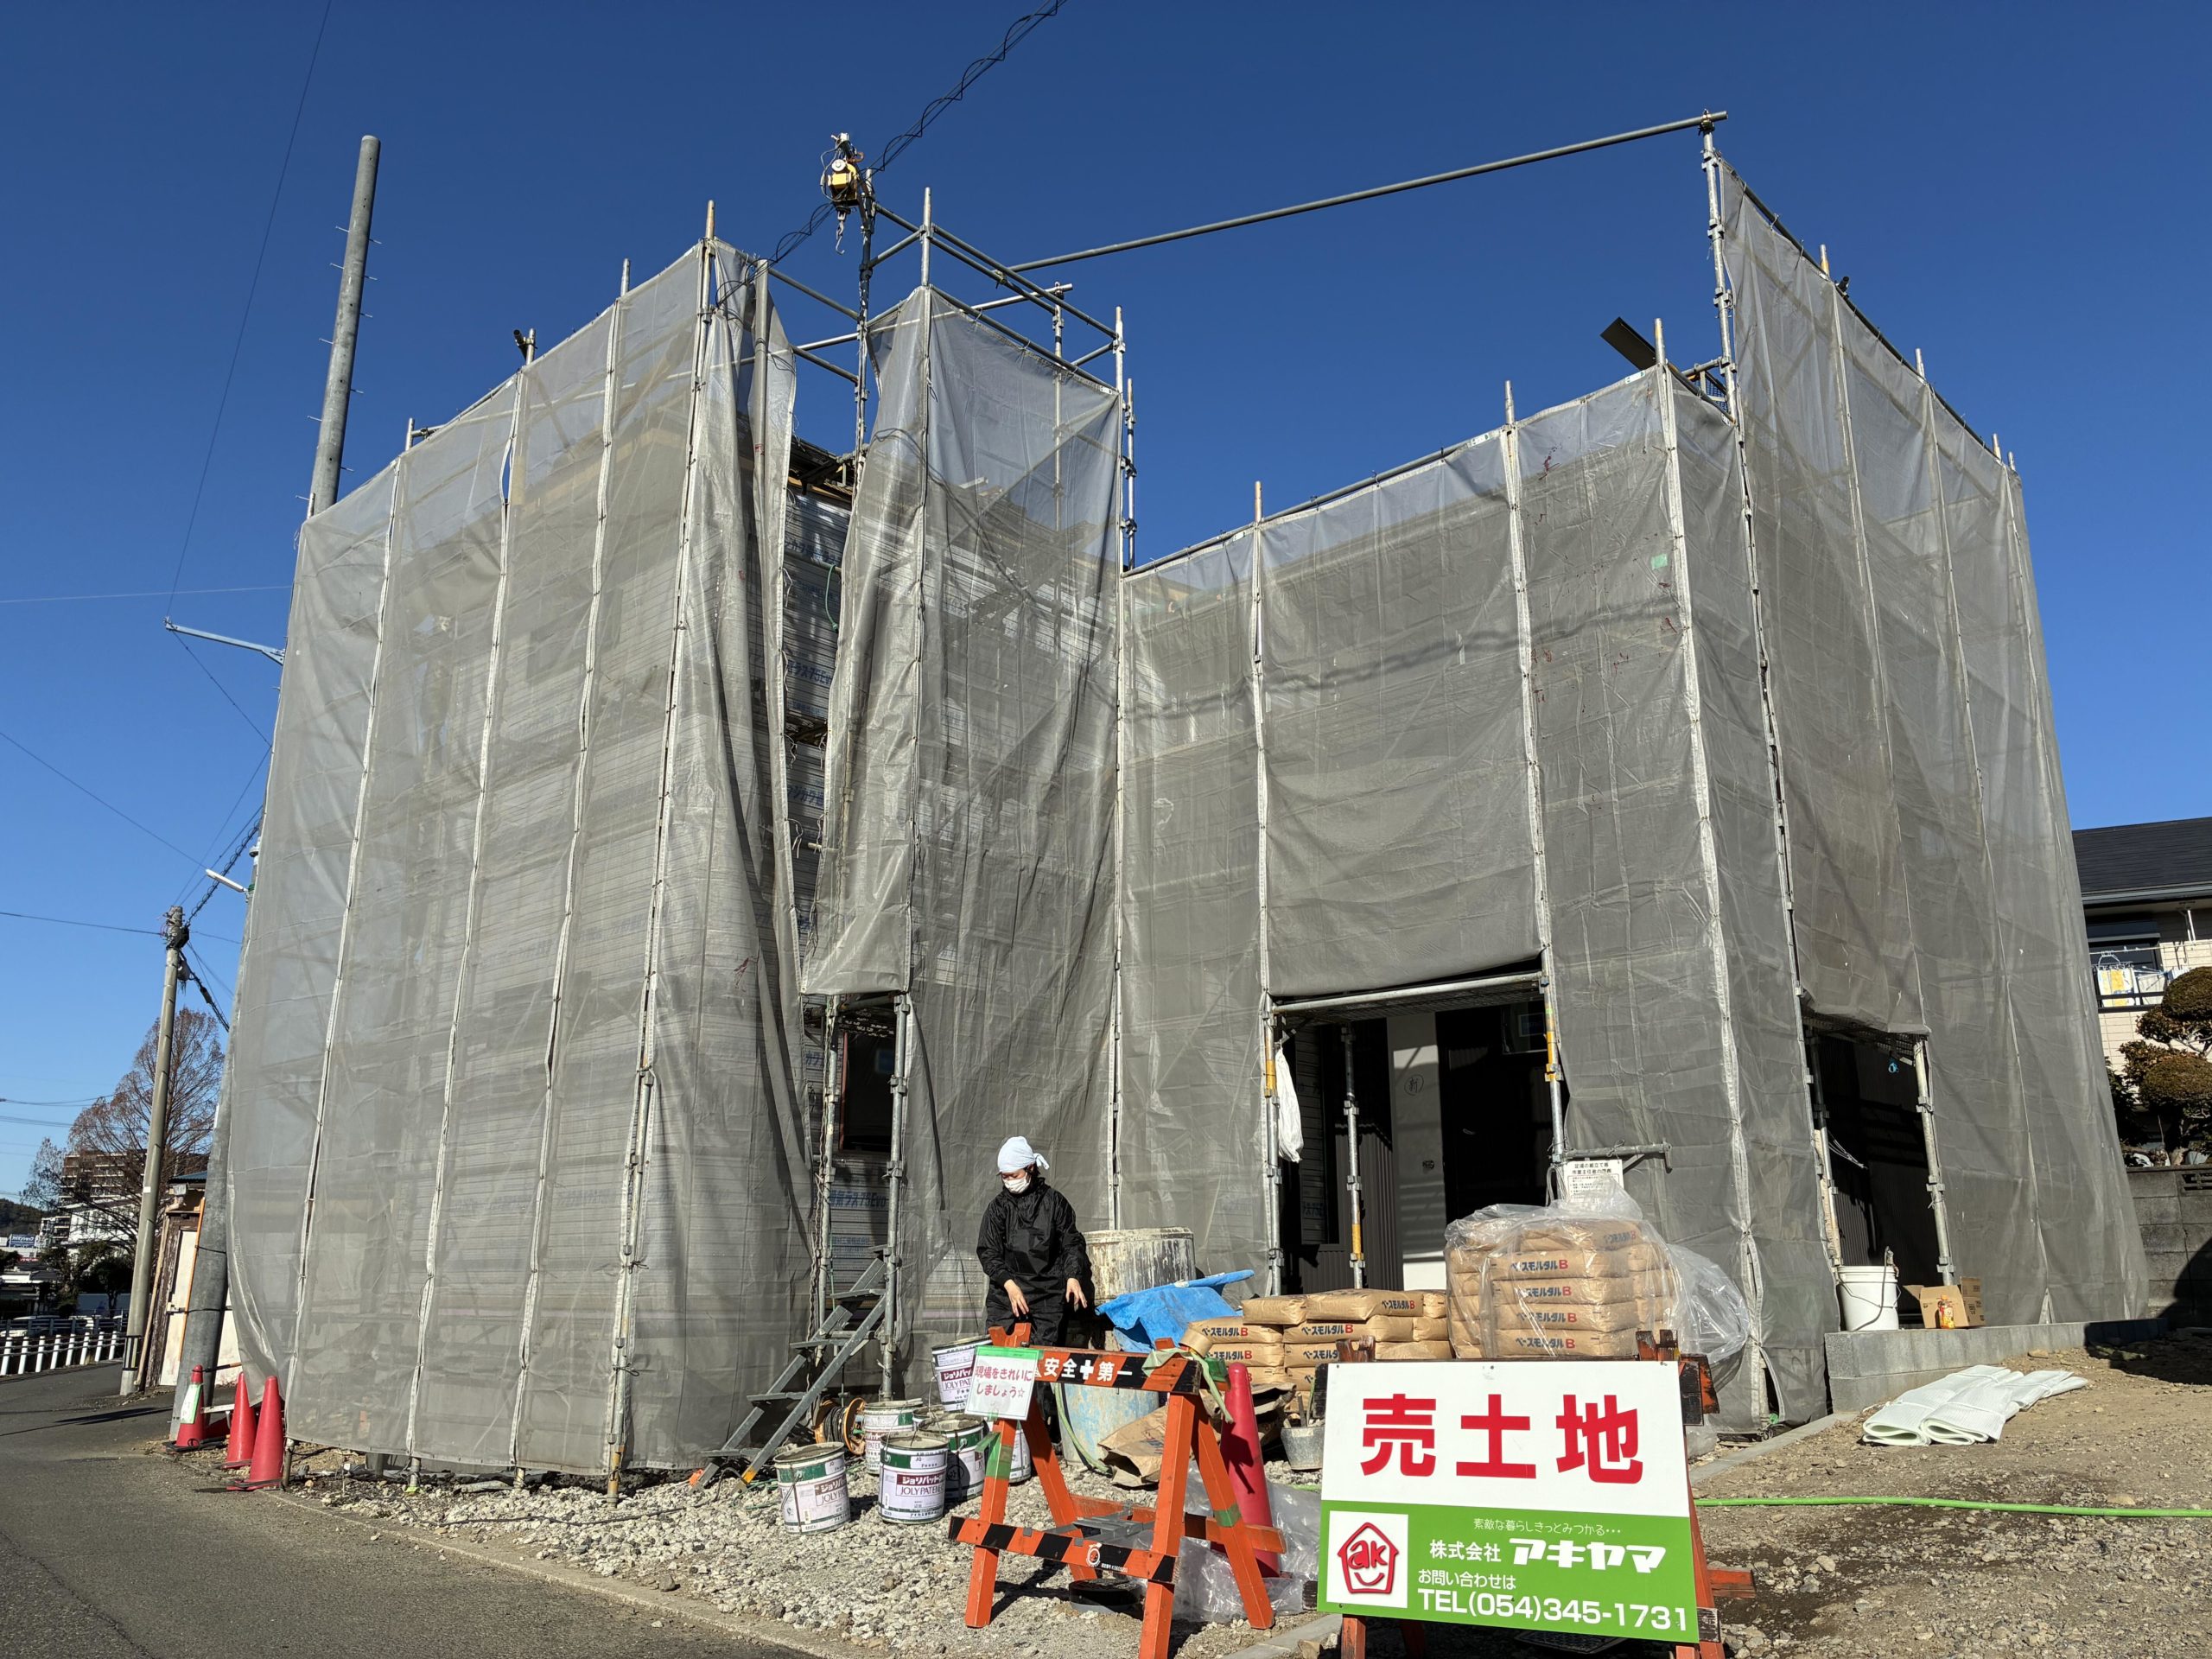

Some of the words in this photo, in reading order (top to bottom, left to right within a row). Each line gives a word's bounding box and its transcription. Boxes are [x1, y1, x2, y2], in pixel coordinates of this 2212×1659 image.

[1510, 1259, 1569, 1271] ベスモルタルB
[1202, 1326, 1249, 1337] ベースモルタルB
[1301, 1325, 1353, 1335] ベースモルタルB
[975, 1365, 1033, 1382] 現場をきれいに
[1360, 1393, 1643, 1484] 売土地
[1429, 1539, 1502, 1562] 株式会社
[1509, 1537, 1667, 1573] アキヤマ
[1418, 1569, 1516, 1590] お問い合わせは
[1417, 1588, 1686, 1631] TEL(054)345-1731
